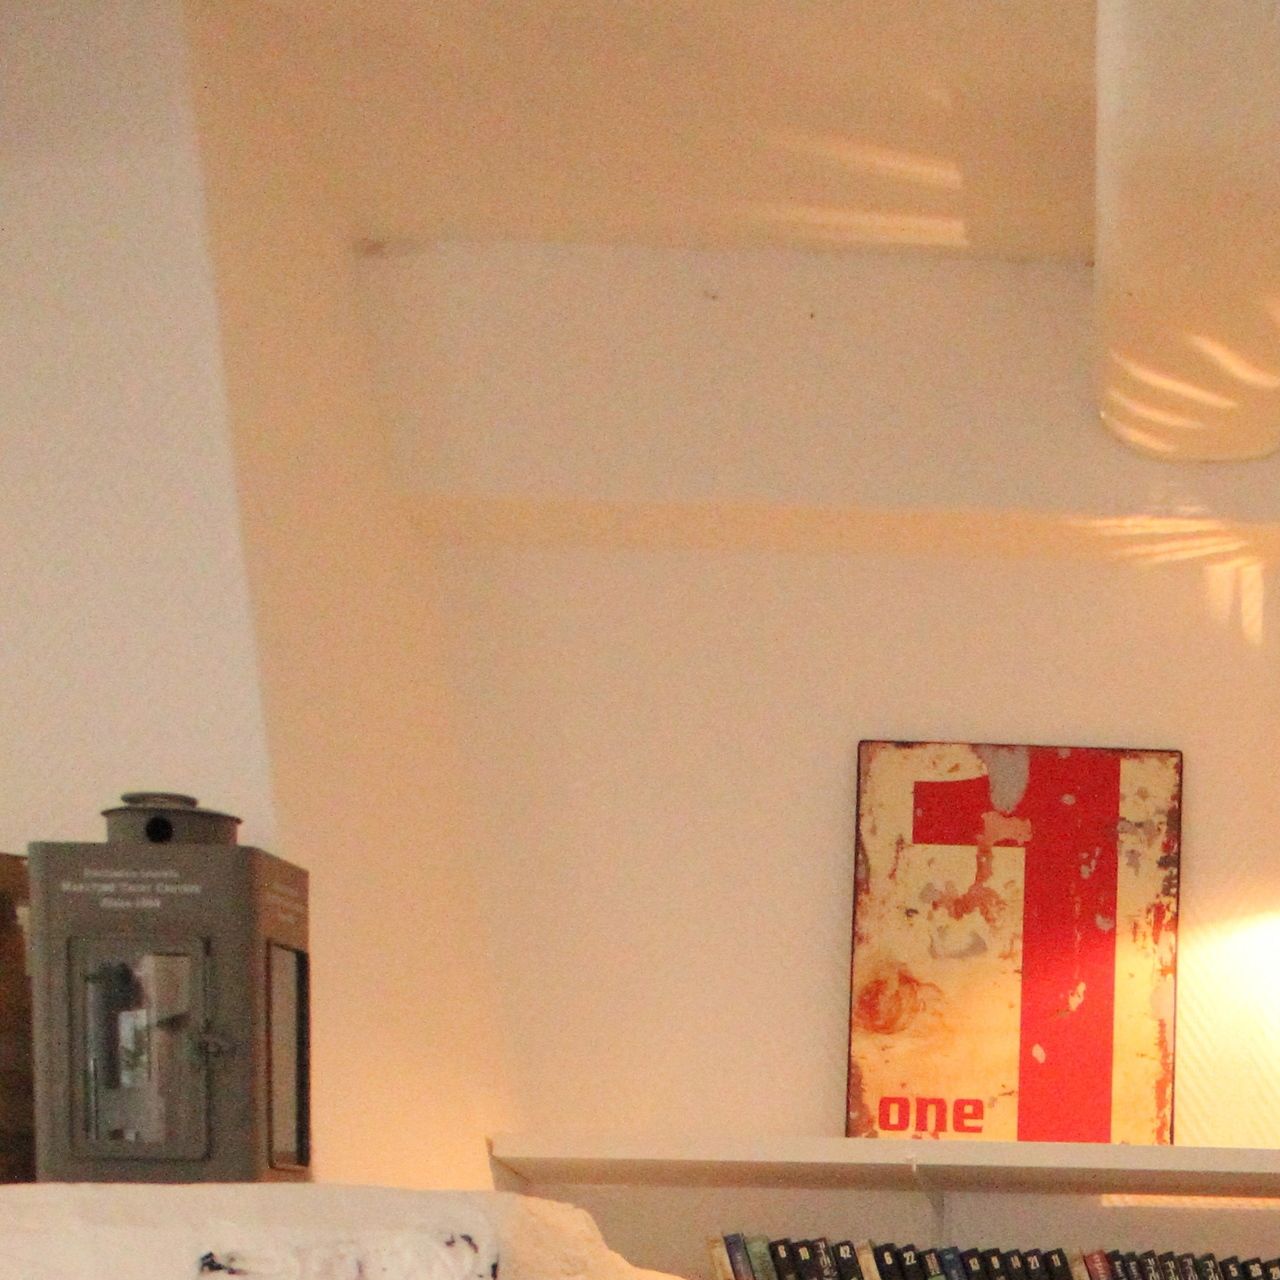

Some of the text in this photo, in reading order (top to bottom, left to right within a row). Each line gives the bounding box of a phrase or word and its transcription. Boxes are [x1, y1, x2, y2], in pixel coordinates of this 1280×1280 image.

[913, 747, 1121, 1142] 1
[878, 1096, 984, 1133] one
[838, 1244, 852, 1259] 42
[902, 1250, 916, 1265] 22
